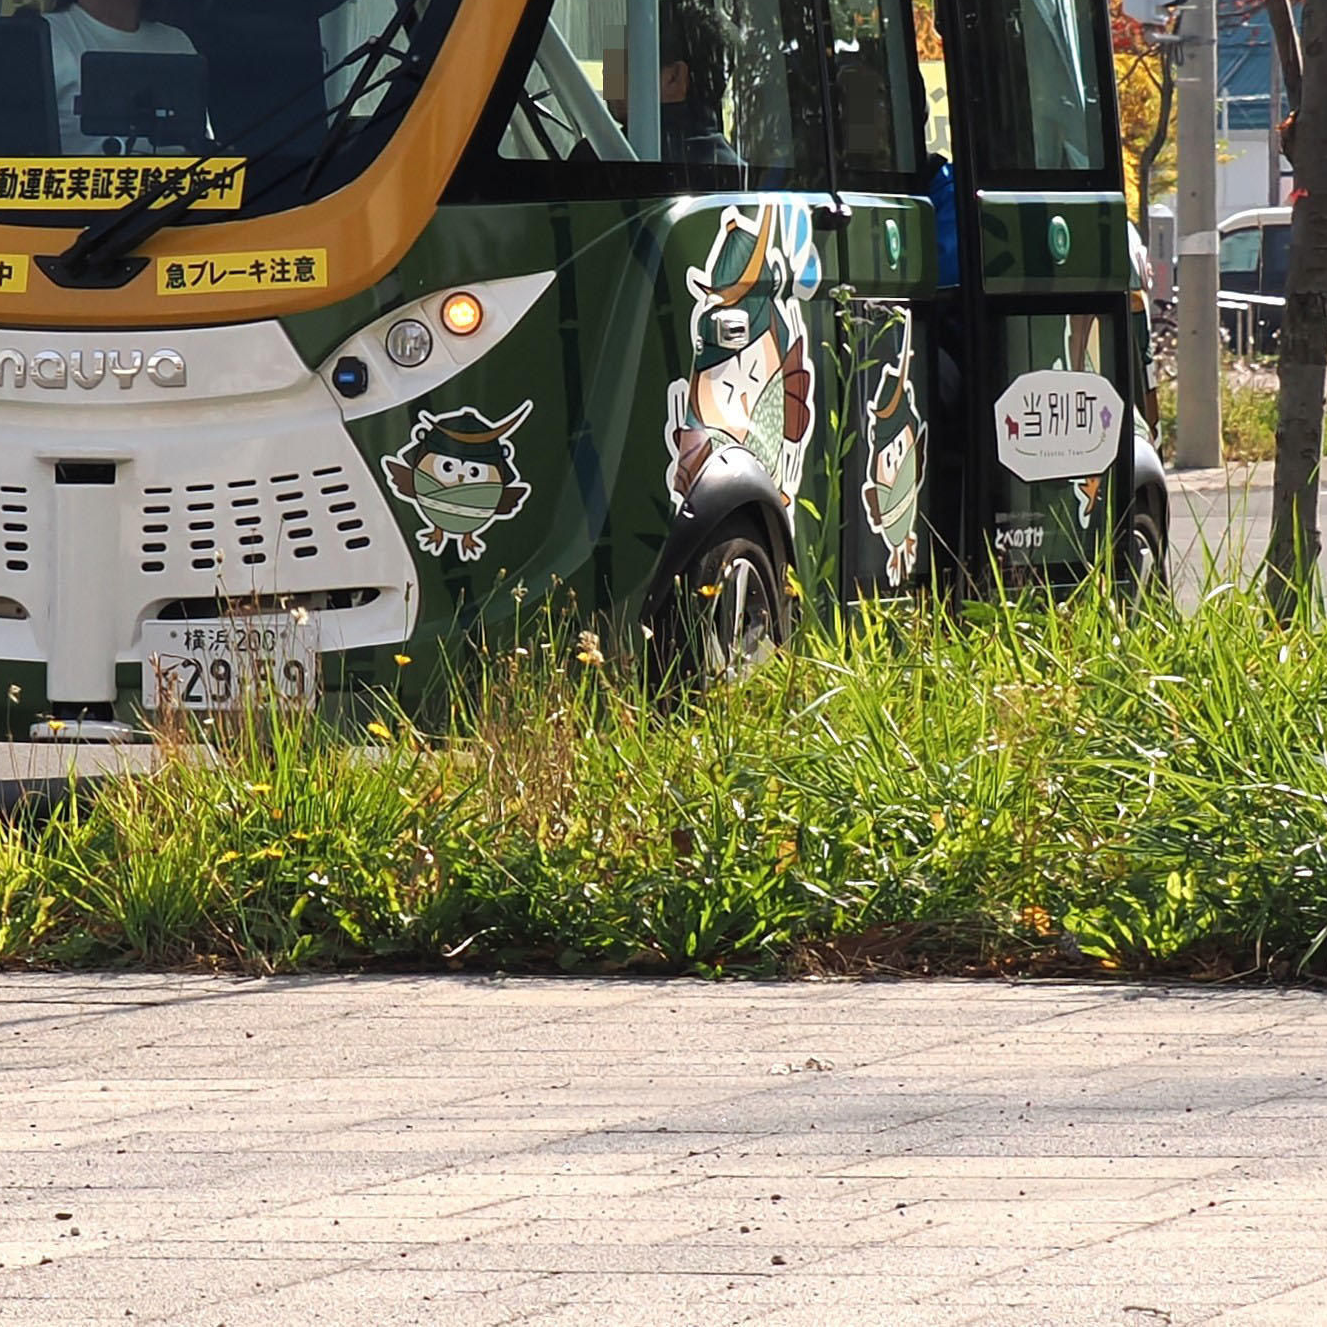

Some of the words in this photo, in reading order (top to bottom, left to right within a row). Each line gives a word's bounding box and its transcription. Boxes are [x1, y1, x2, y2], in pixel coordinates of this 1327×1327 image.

[166, 256, 317, 289] 急ブレーキ注意
[1023, 391, 1097, 437] 当別町
[995, 526, 1044, 552] とべのすけ
